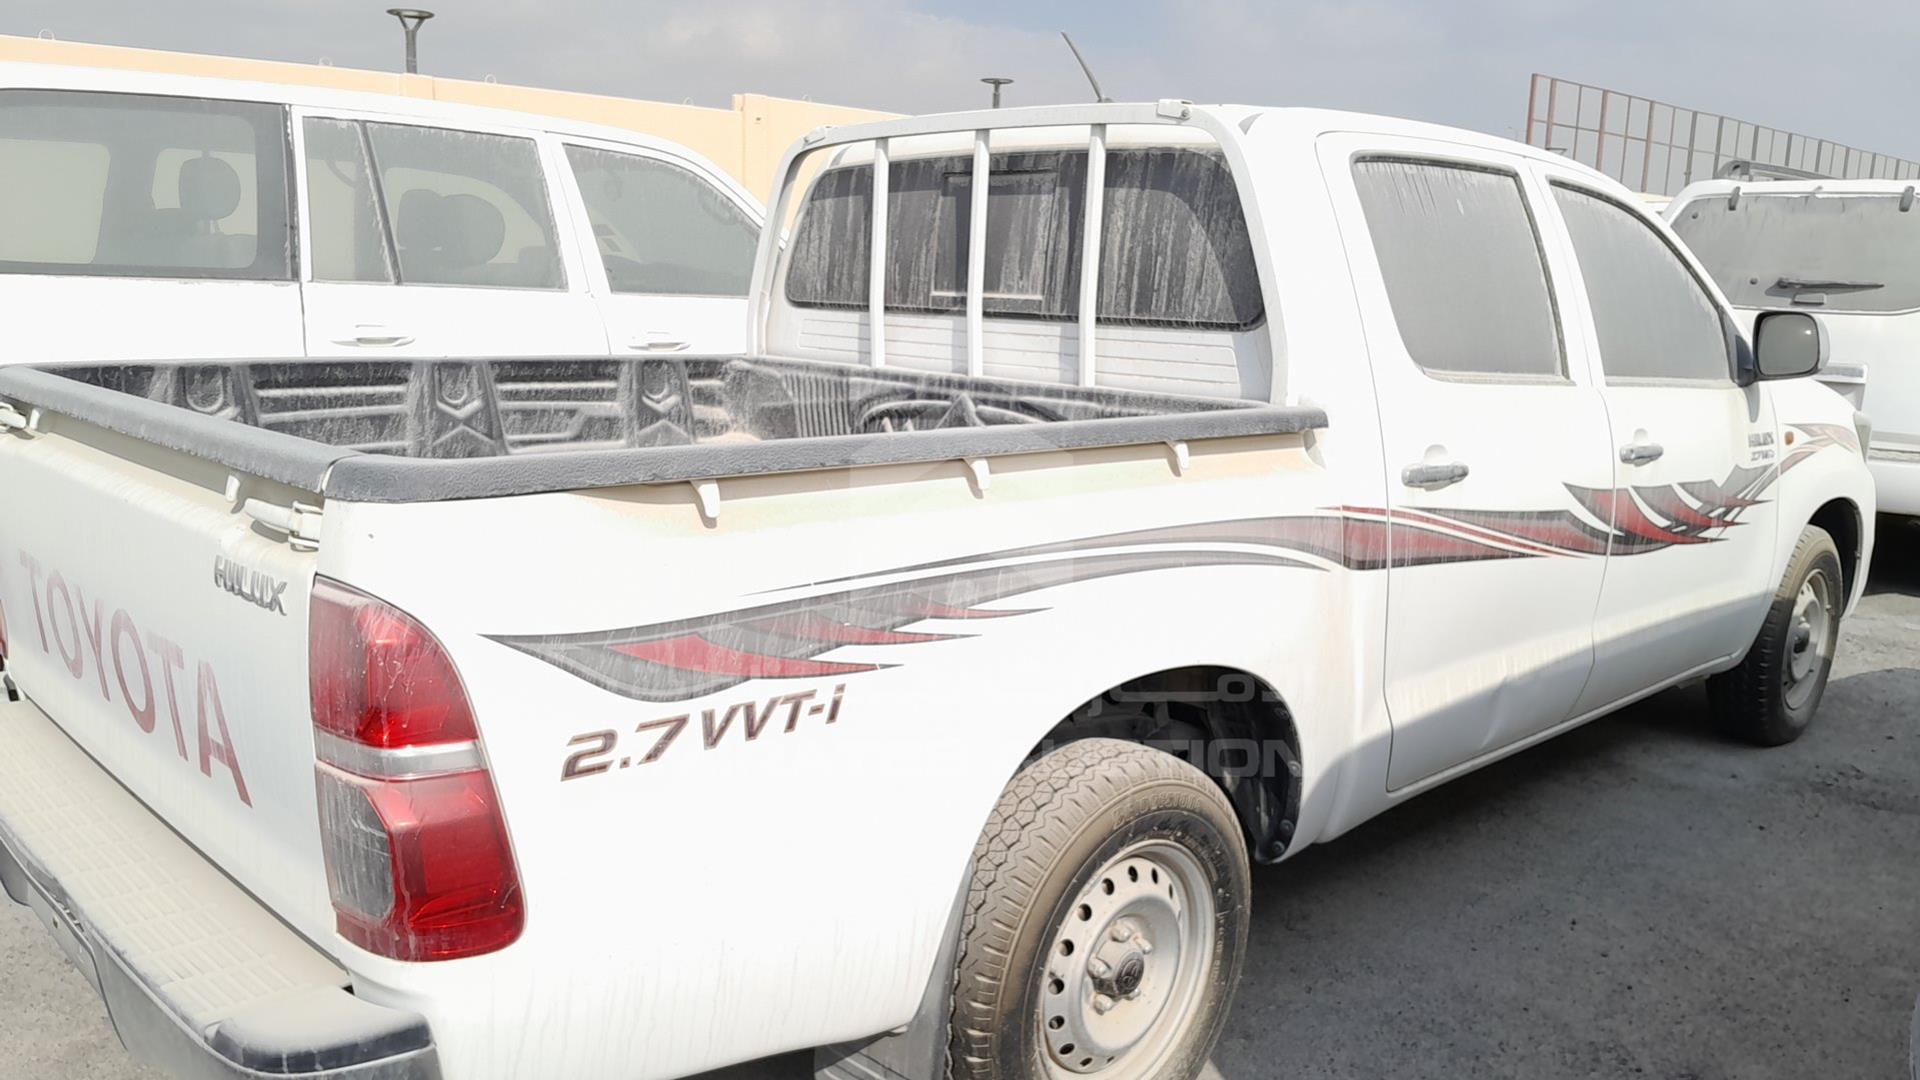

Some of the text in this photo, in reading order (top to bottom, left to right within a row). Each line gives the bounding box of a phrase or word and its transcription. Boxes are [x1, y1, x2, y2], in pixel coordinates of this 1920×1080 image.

[214, 554, 288, 616] HILUX
[19, 549, 253, 808] TOYOTA
[560, 713, 690, 782] 2.7
[701, 683, 846, 751] VVT-i
